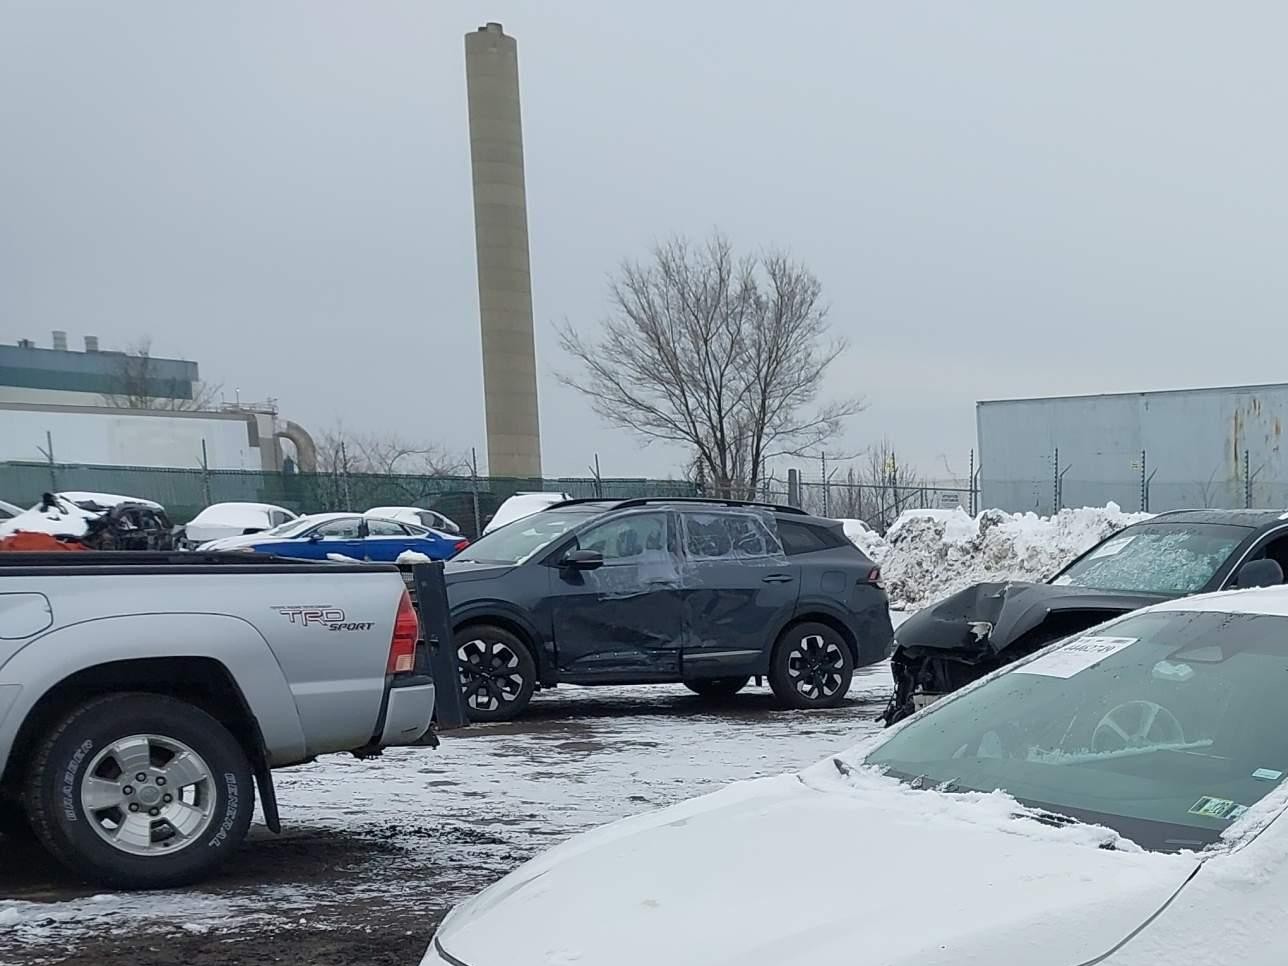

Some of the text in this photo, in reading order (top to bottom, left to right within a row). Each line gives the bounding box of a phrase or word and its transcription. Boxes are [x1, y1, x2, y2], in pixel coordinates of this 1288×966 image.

[280, 608, 345, 627] TRD
[328, 622, 375, 632] SPORT
[208, 773, 239, 847] GENERAL
